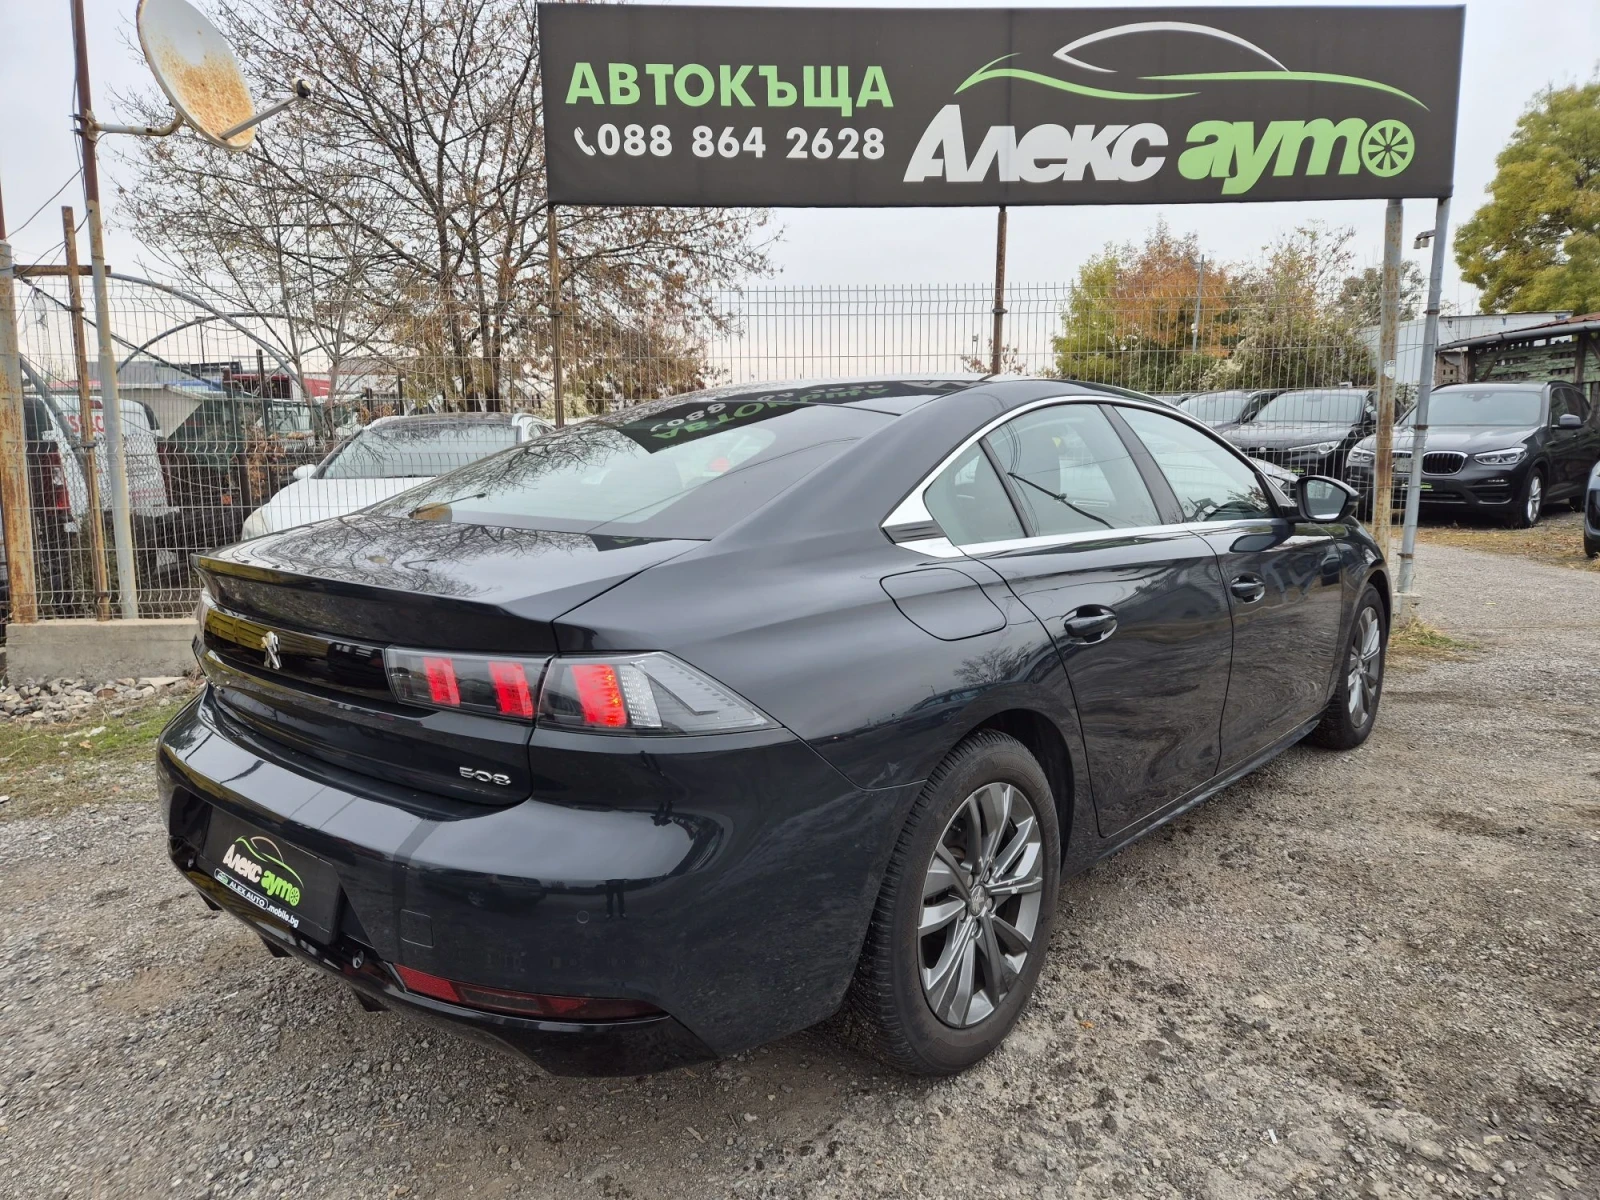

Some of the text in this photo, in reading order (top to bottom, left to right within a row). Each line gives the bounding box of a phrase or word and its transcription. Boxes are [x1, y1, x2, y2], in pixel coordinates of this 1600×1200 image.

[565, 62, 894, 117] АВТОКЪЩА
[597, 123, 885, 159] 088 864 2628
[459, 766, 511, 785] 508
[229, 881, 246, 896] ALEX
[246, 892, 265, 906] AUTO
